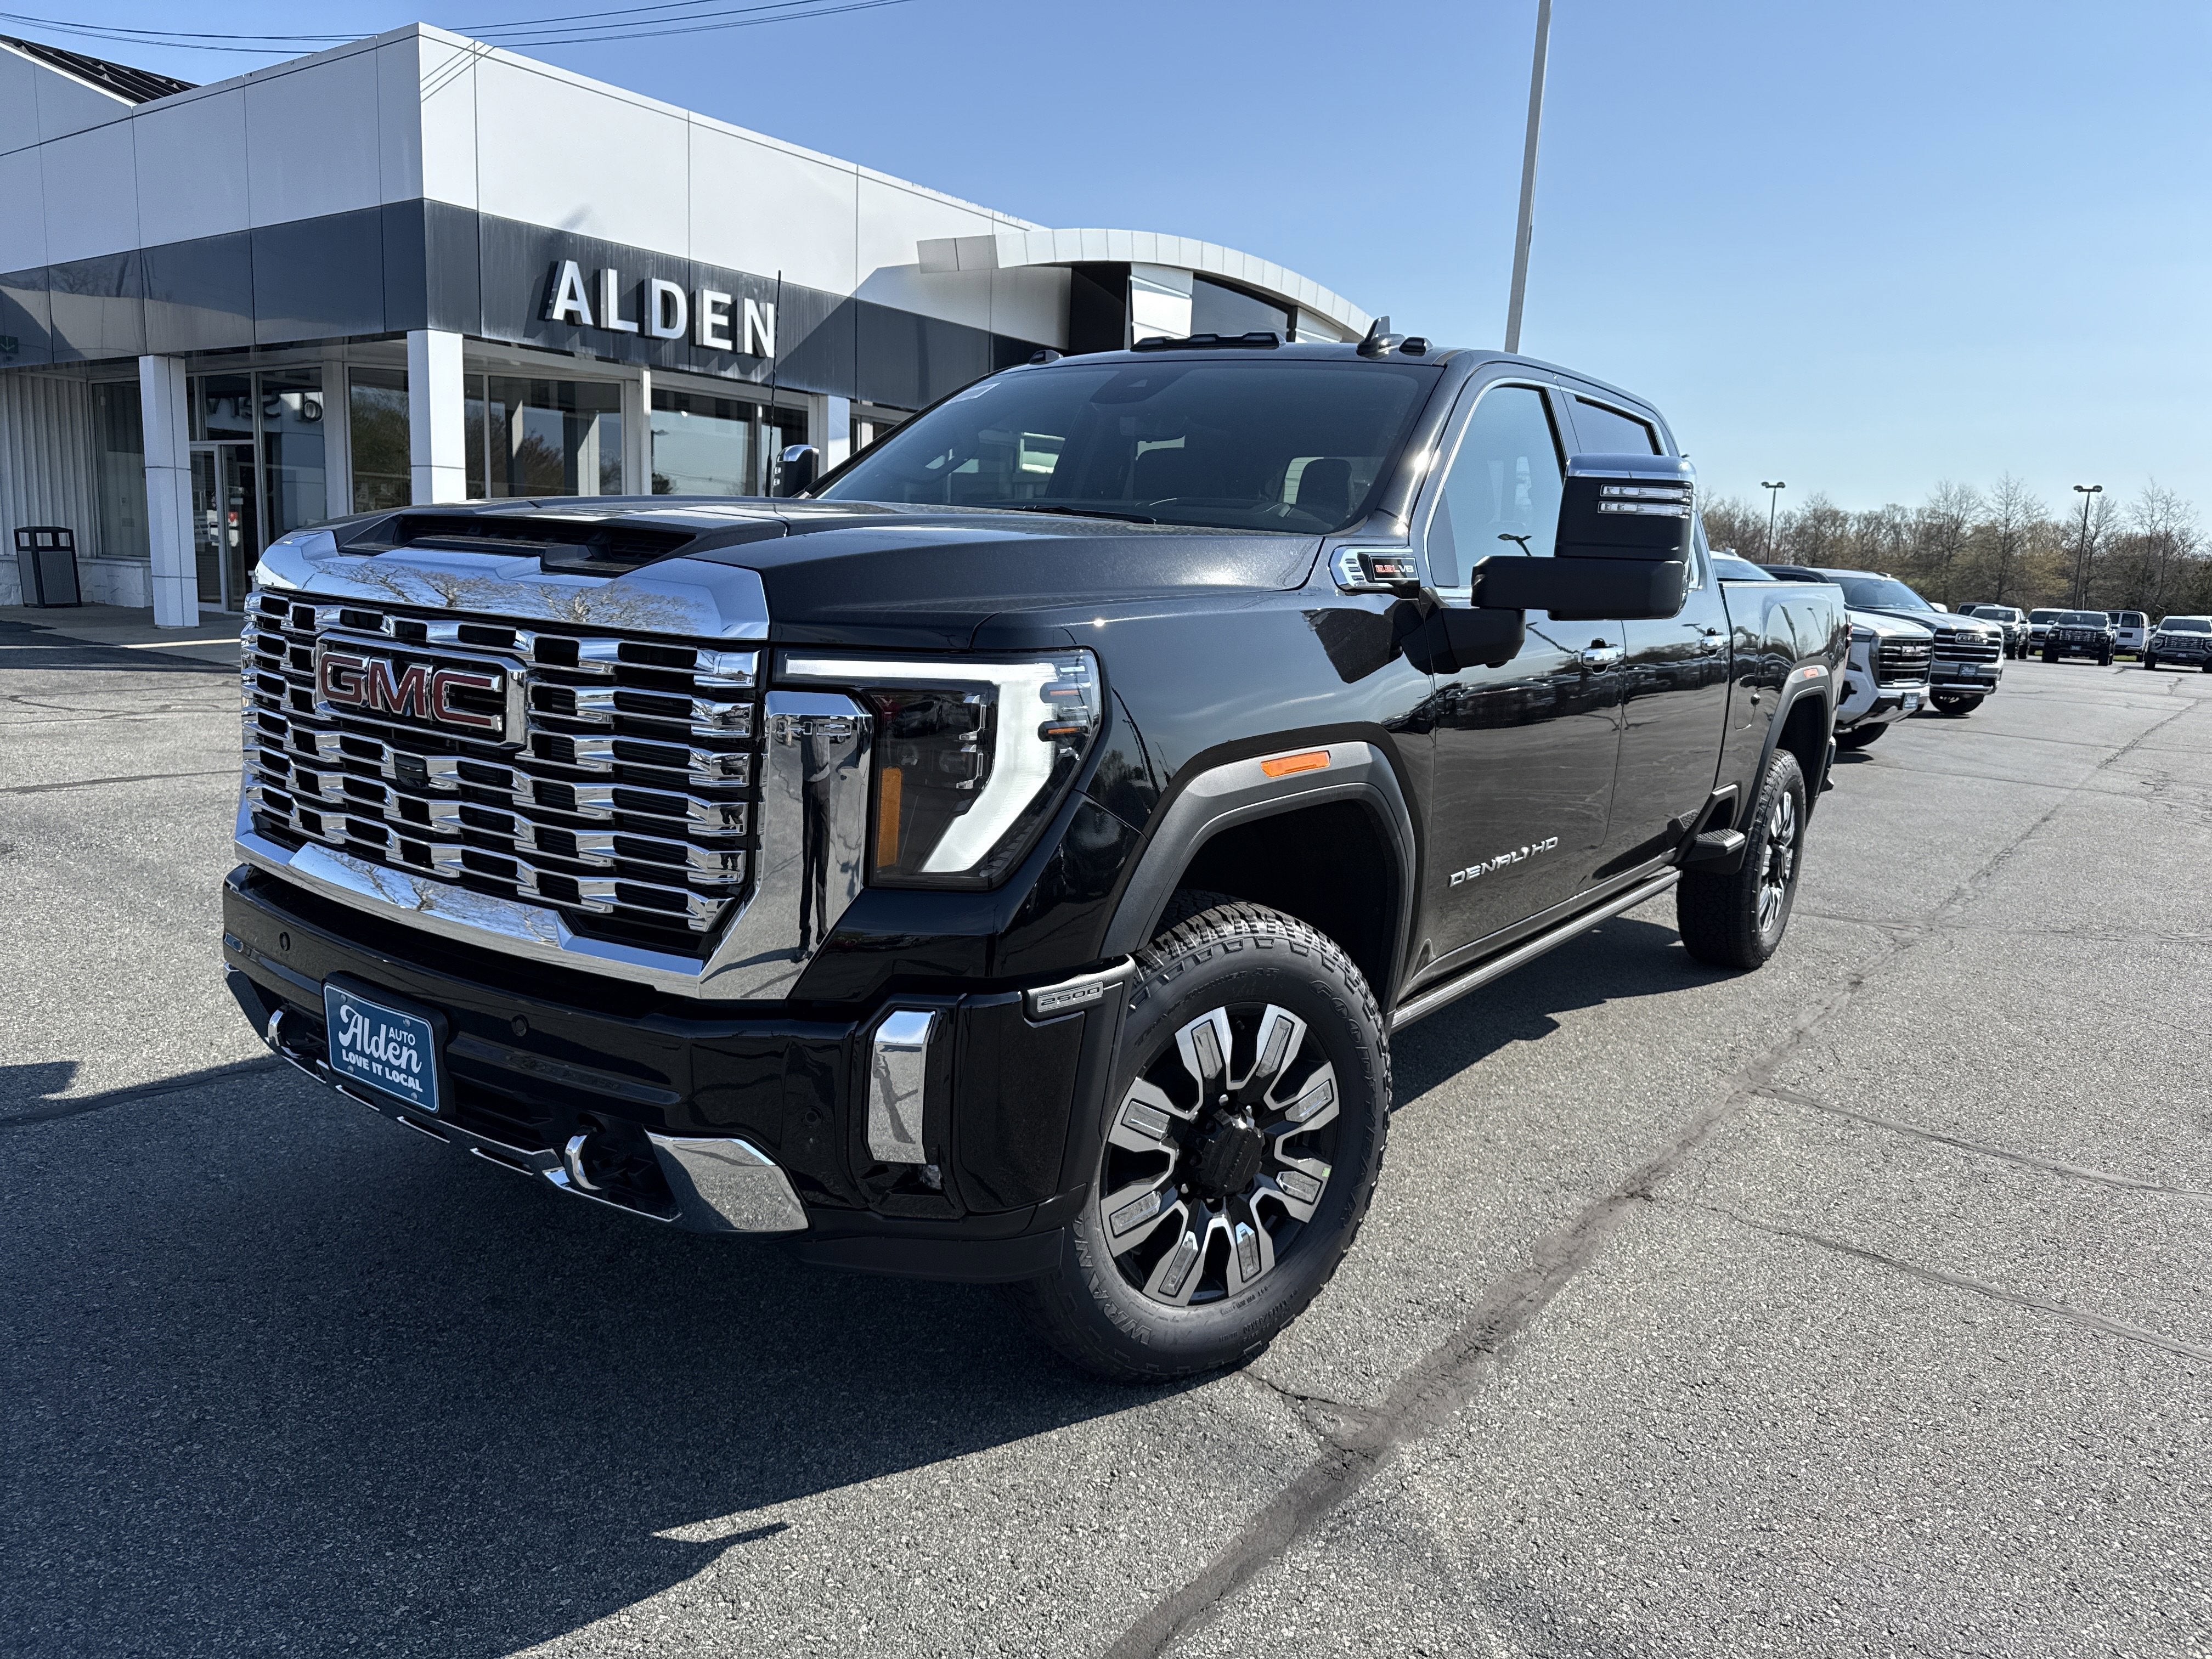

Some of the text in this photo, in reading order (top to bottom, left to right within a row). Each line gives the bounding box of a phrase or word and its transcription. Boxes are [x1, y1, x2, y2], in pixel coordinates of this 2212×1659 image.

[545, 259, 775, 359] ALDEN
[1398, 565, 1414, 573] V8
[320, 651, 503, 732] GMC
[1449, 836, 1559, 888] DENALI HD
[1041, 987, 1100, 1006] 2500
[338, 1004, 422, 1074] Alden
[388, 1026, 416, 1046] AUTO
[342, 1048, 423, 1093] LOVE IT LOCAL
[1308, 980, 1376, 1228] GOODYEAR
